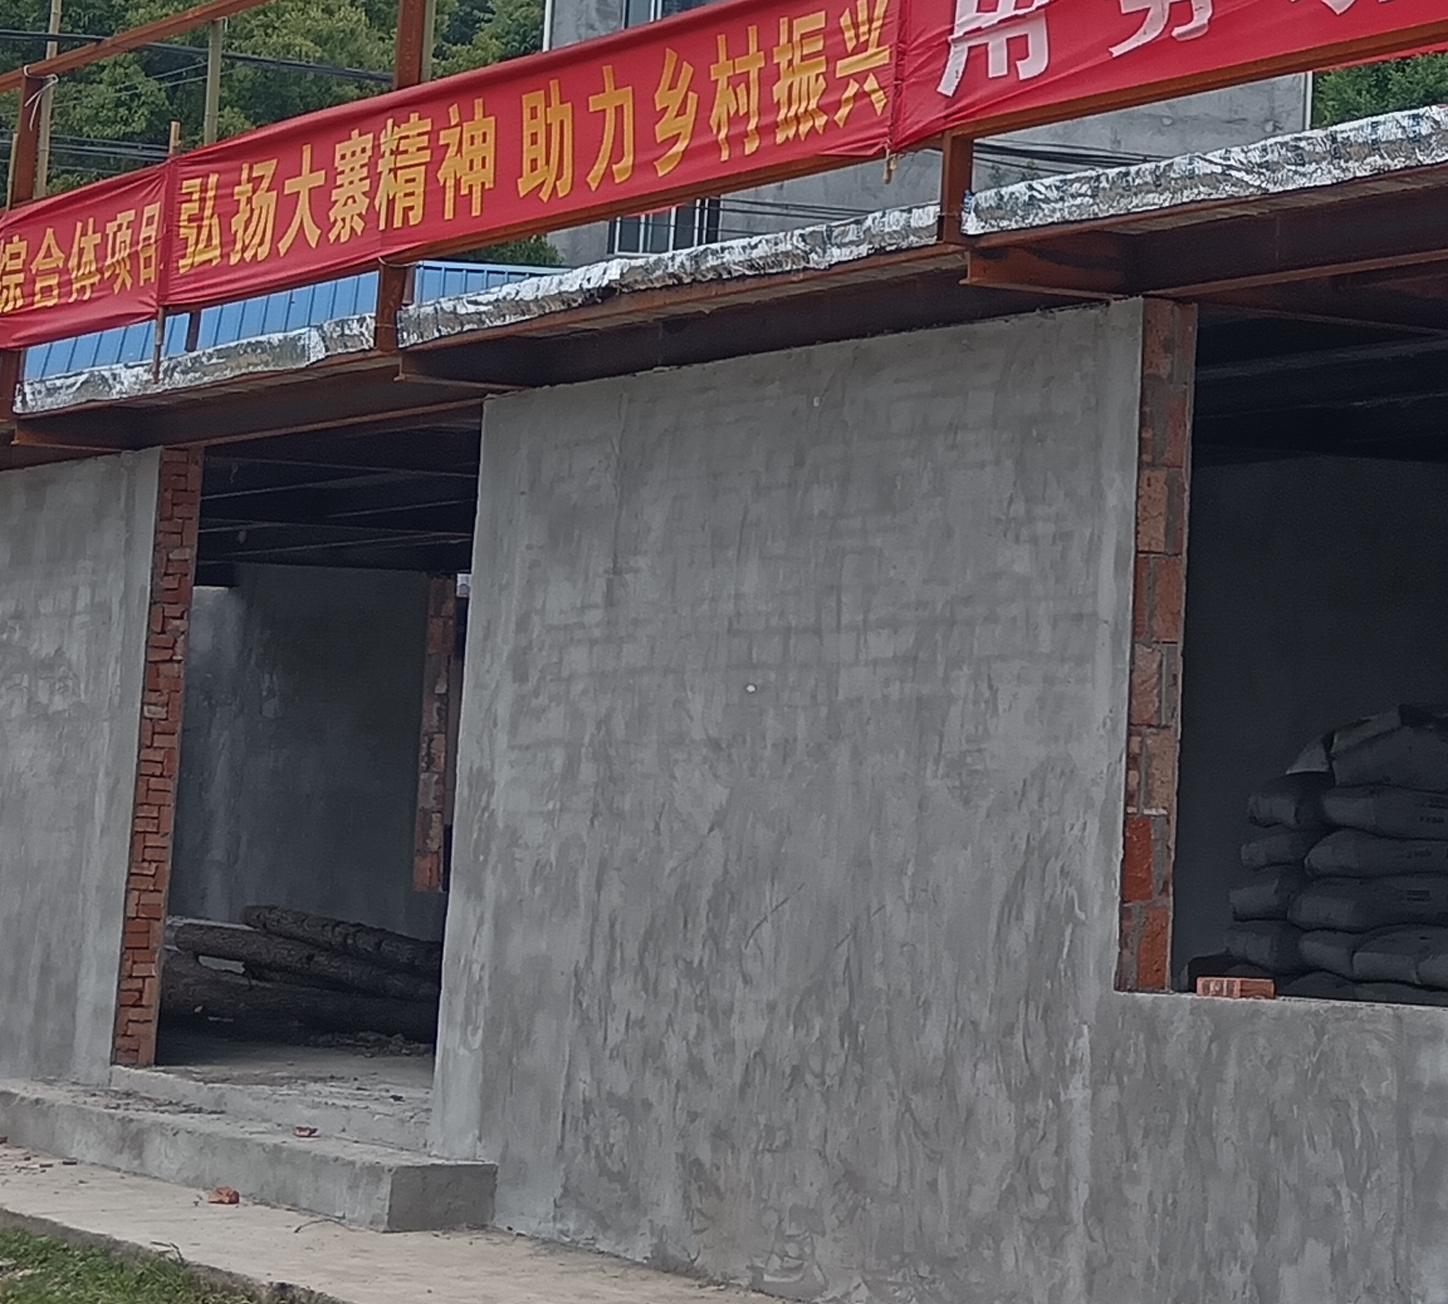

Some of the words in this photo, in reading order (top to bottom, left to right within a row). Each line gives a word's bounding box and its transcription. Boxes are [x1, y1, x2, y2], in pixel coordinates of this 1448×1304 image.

[177, 97, 497, 274] 弘扬大寨精神
